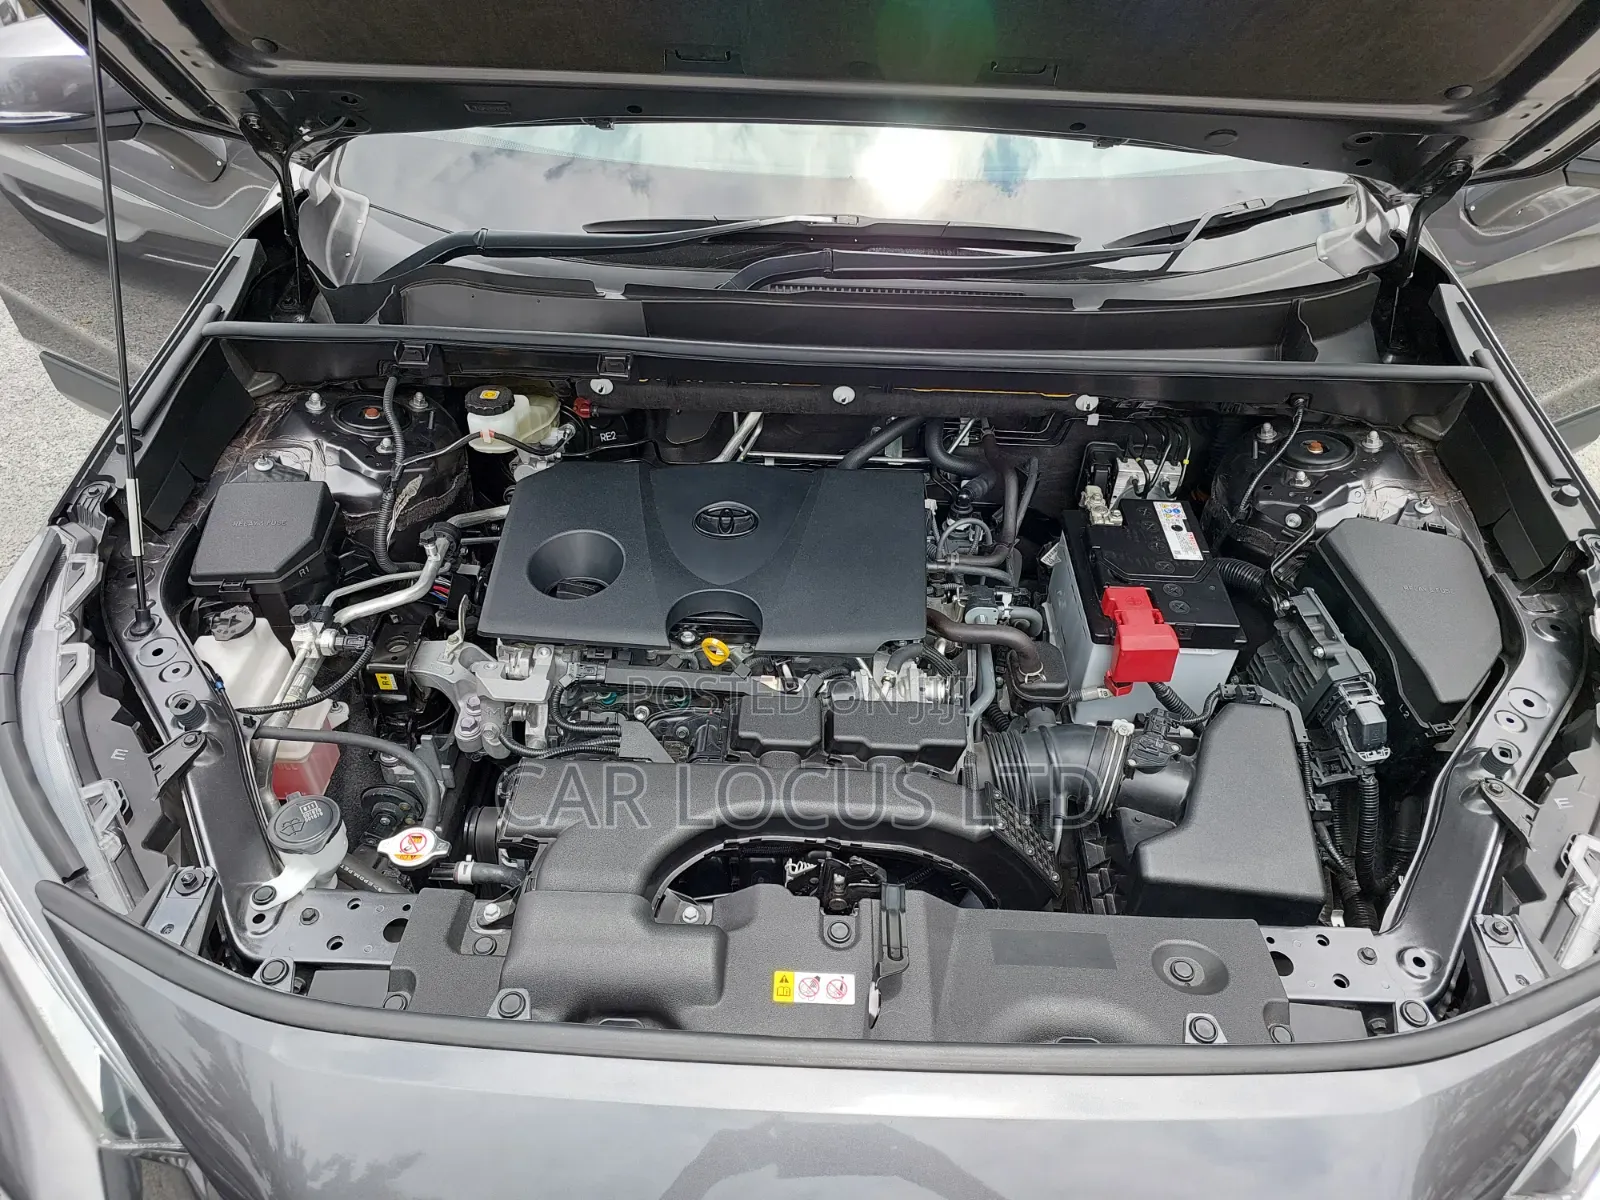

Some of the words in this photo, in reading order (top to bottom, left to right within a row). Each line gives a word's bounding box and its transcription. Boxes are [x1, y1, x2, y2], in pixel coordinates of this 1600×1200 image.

[599, 430, 617, 442] RE2
[298, 565, 310, 578] R1
[380, 675, 391, 686] R4
